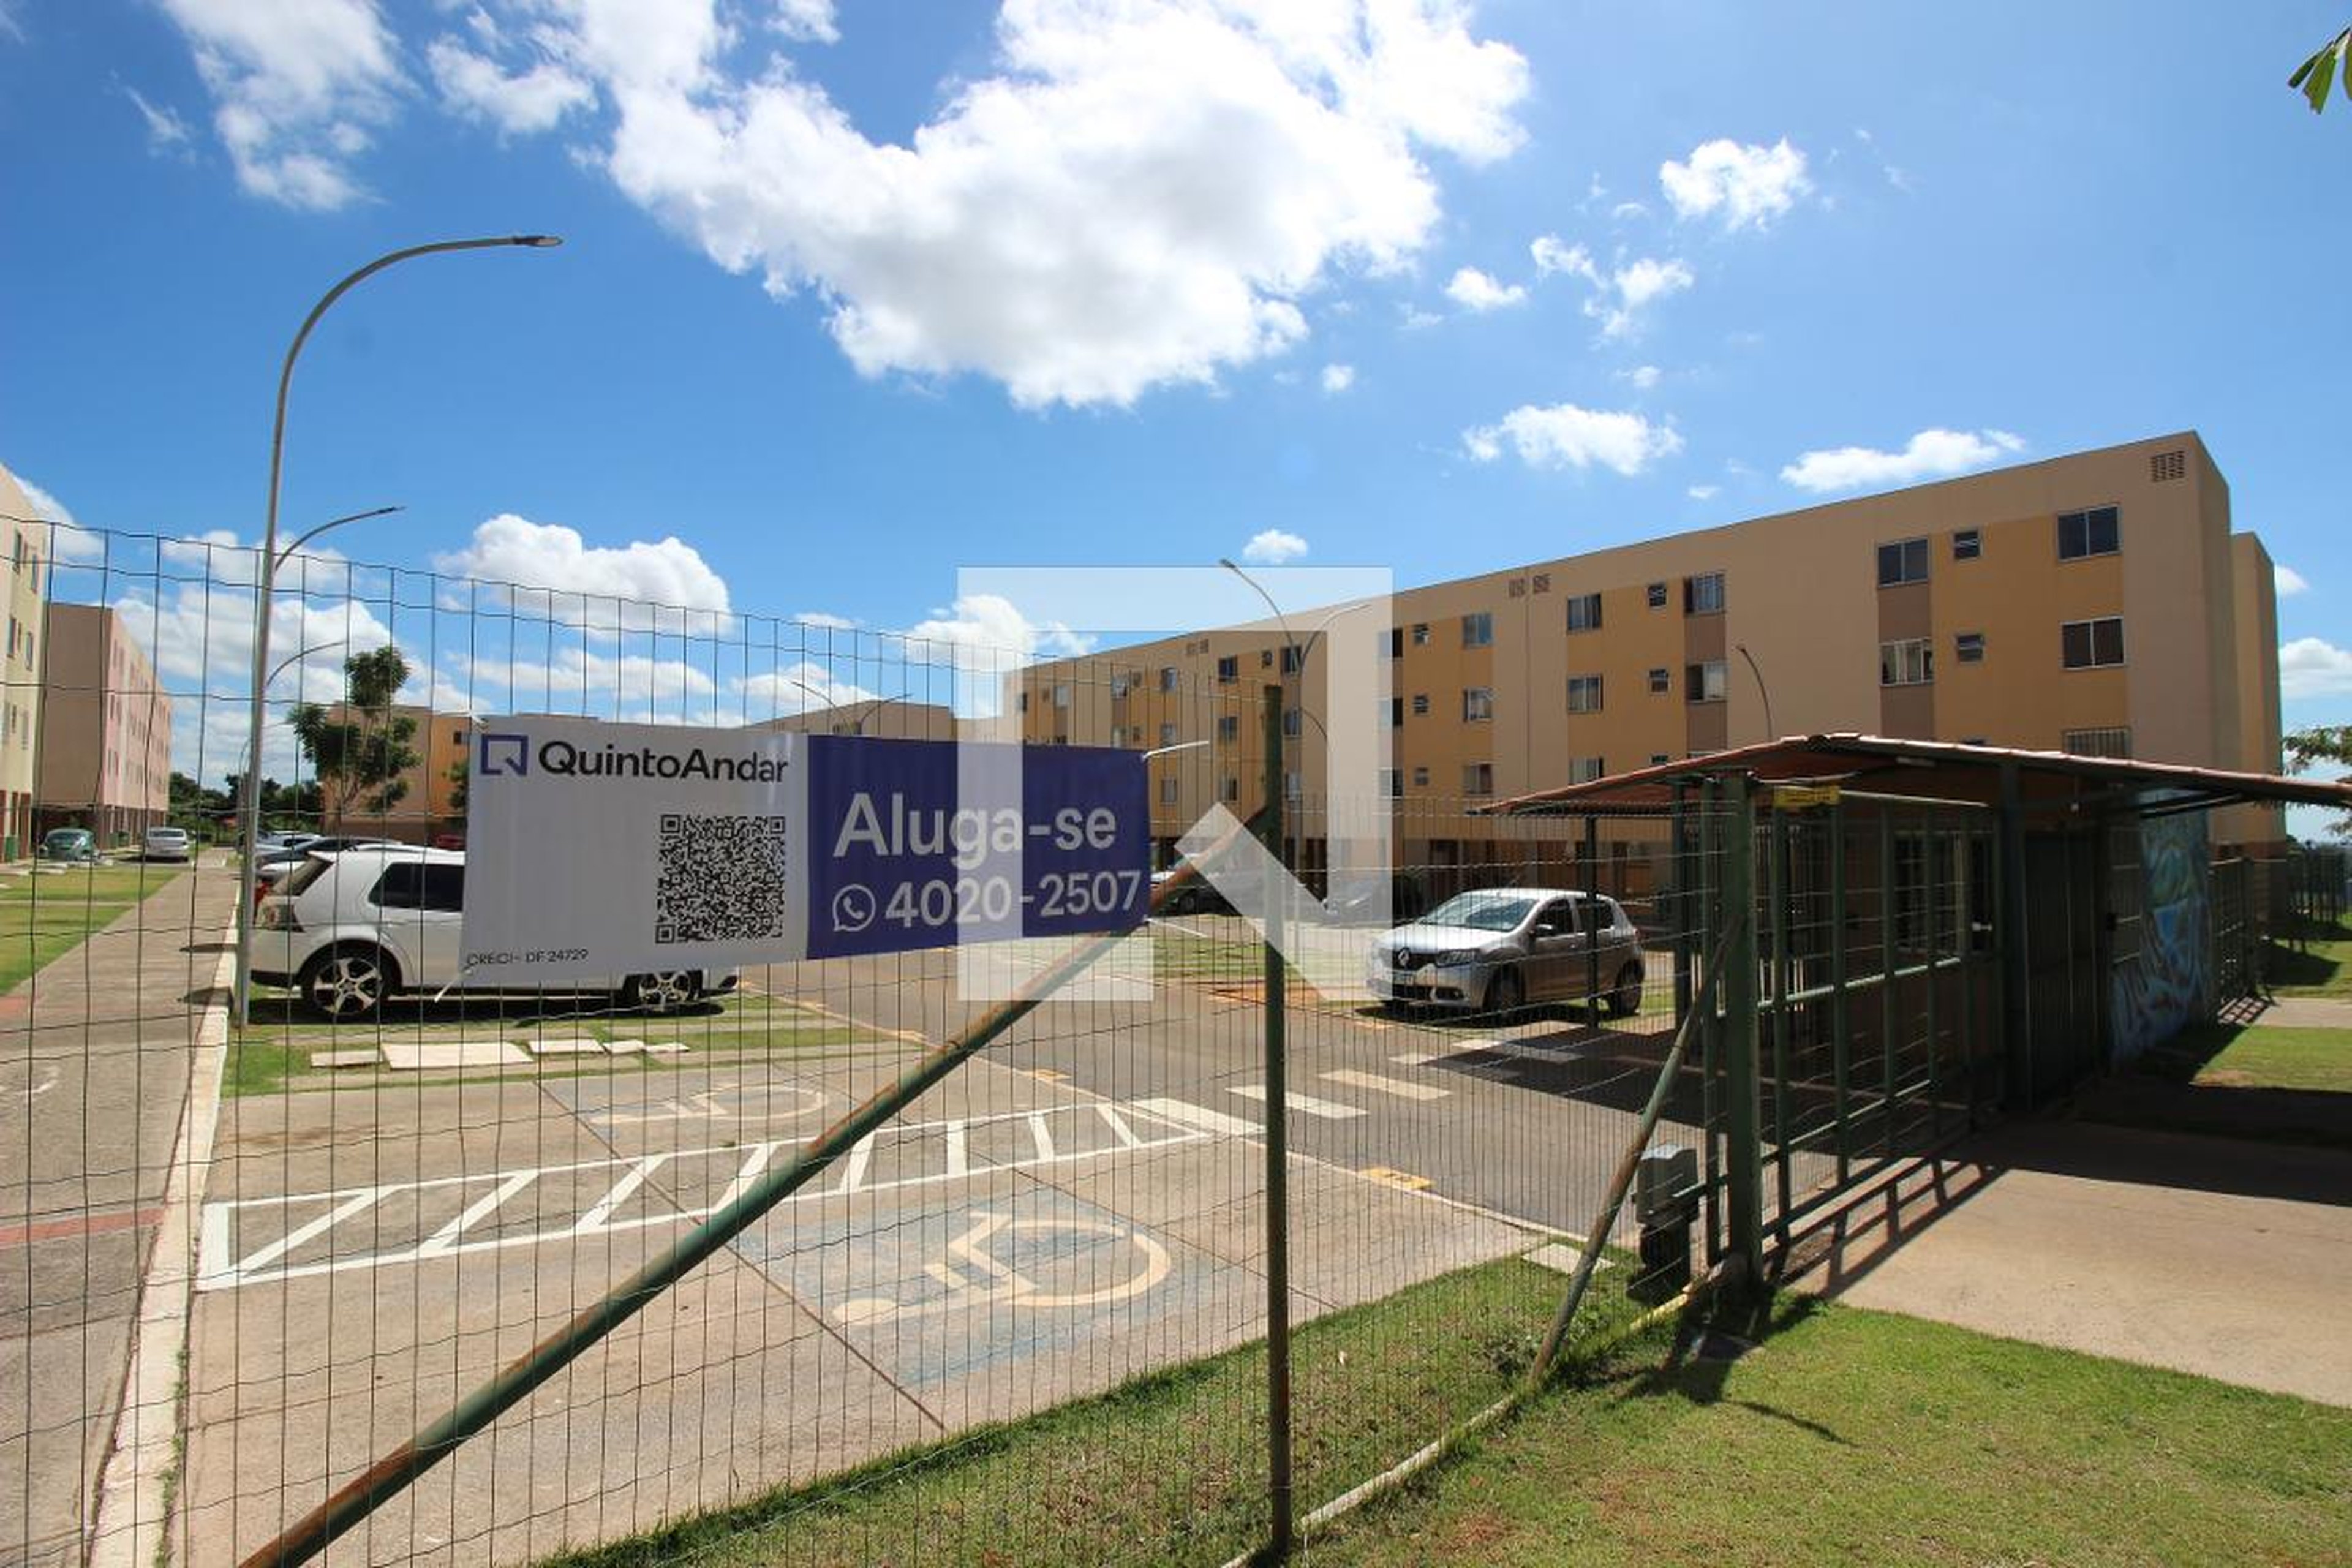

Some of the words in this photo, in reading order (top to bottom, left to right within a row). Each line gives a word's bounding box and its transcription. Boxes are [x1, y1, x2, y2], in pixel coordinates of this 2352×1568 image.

[539, 741, 789, 782] QuintoAndar
[834, 793, 1117, 869] Aluga-se
[886, 870, 1141, 927] 4020-2507
[526, 951, 545, 963] DF
